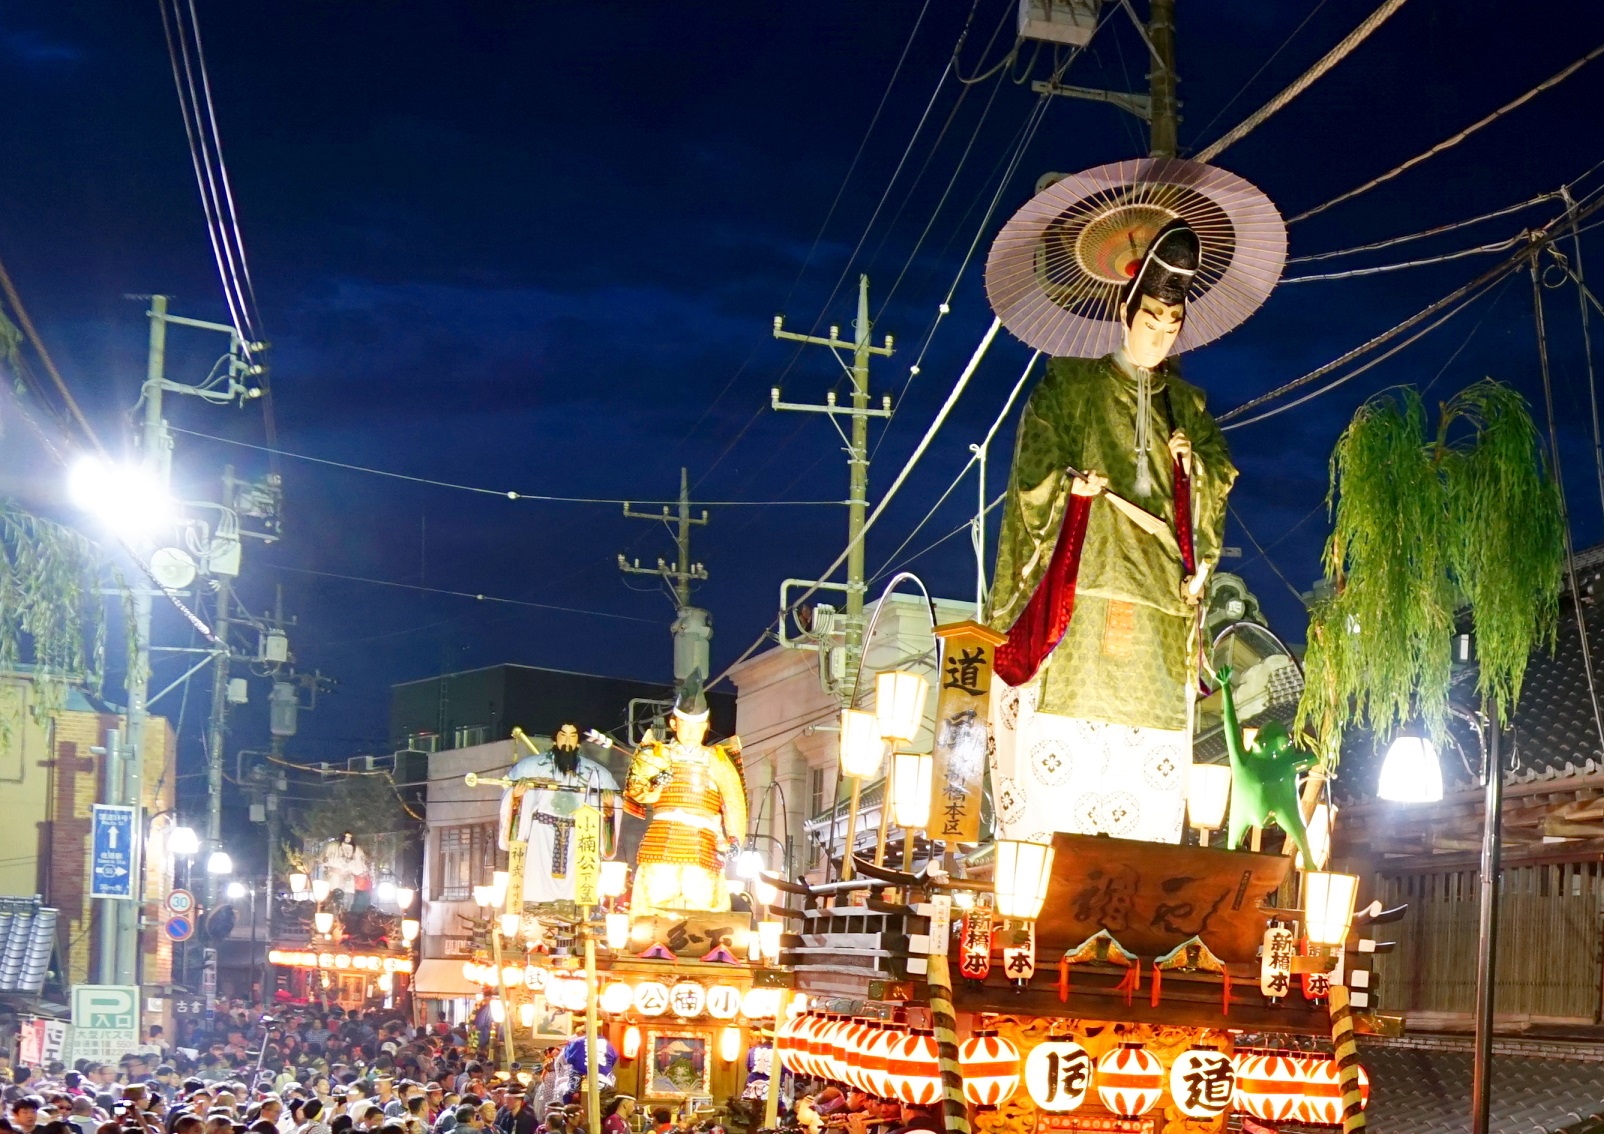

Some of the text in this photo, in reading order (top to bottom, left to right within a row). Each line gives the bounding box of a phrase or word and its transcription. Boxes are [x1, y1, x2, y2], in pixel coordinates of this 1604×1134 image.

[172, 896, 188, 908] 30
[963, 910, 990, 974] 新橋本
[1267, 931, 1292, 992] 新橋本
[95, 1014, 132, 1028] 入口
[177, 1000, 203, 1013] 古書
[1183, 1055, 1236, 1110] 道
